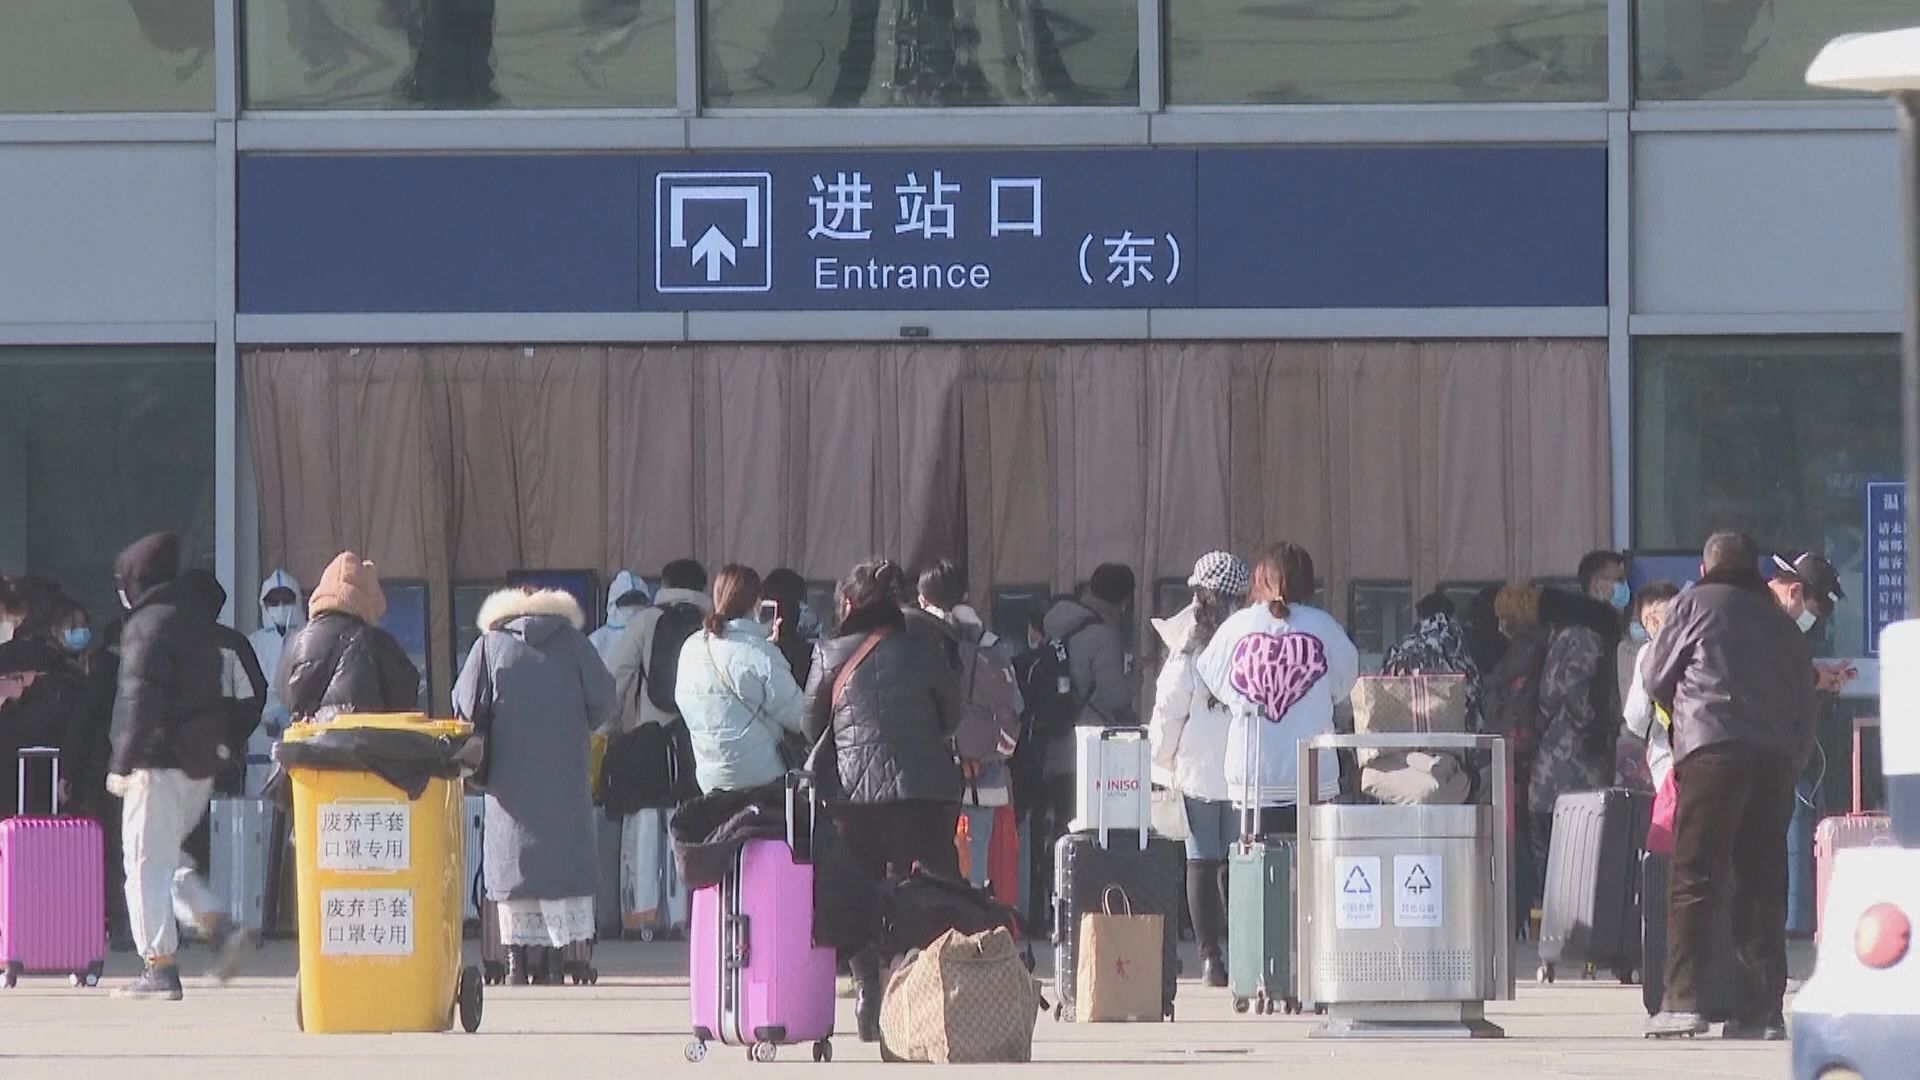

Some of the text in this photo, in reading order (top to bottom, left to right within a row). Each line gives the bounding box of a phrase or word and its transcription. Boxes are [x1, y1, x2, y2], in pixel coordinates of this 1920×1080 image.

[807, 171, 1043, 239] 进站口
[815, 257, 991, 290] Entrance
[322, 812, 404, 832] 废弃手套
[324, 839, 403, 859] 口罩专用
[326, 898, 408, 917] 废弃手套
[328, 924, 407, 945] 口罩专用
